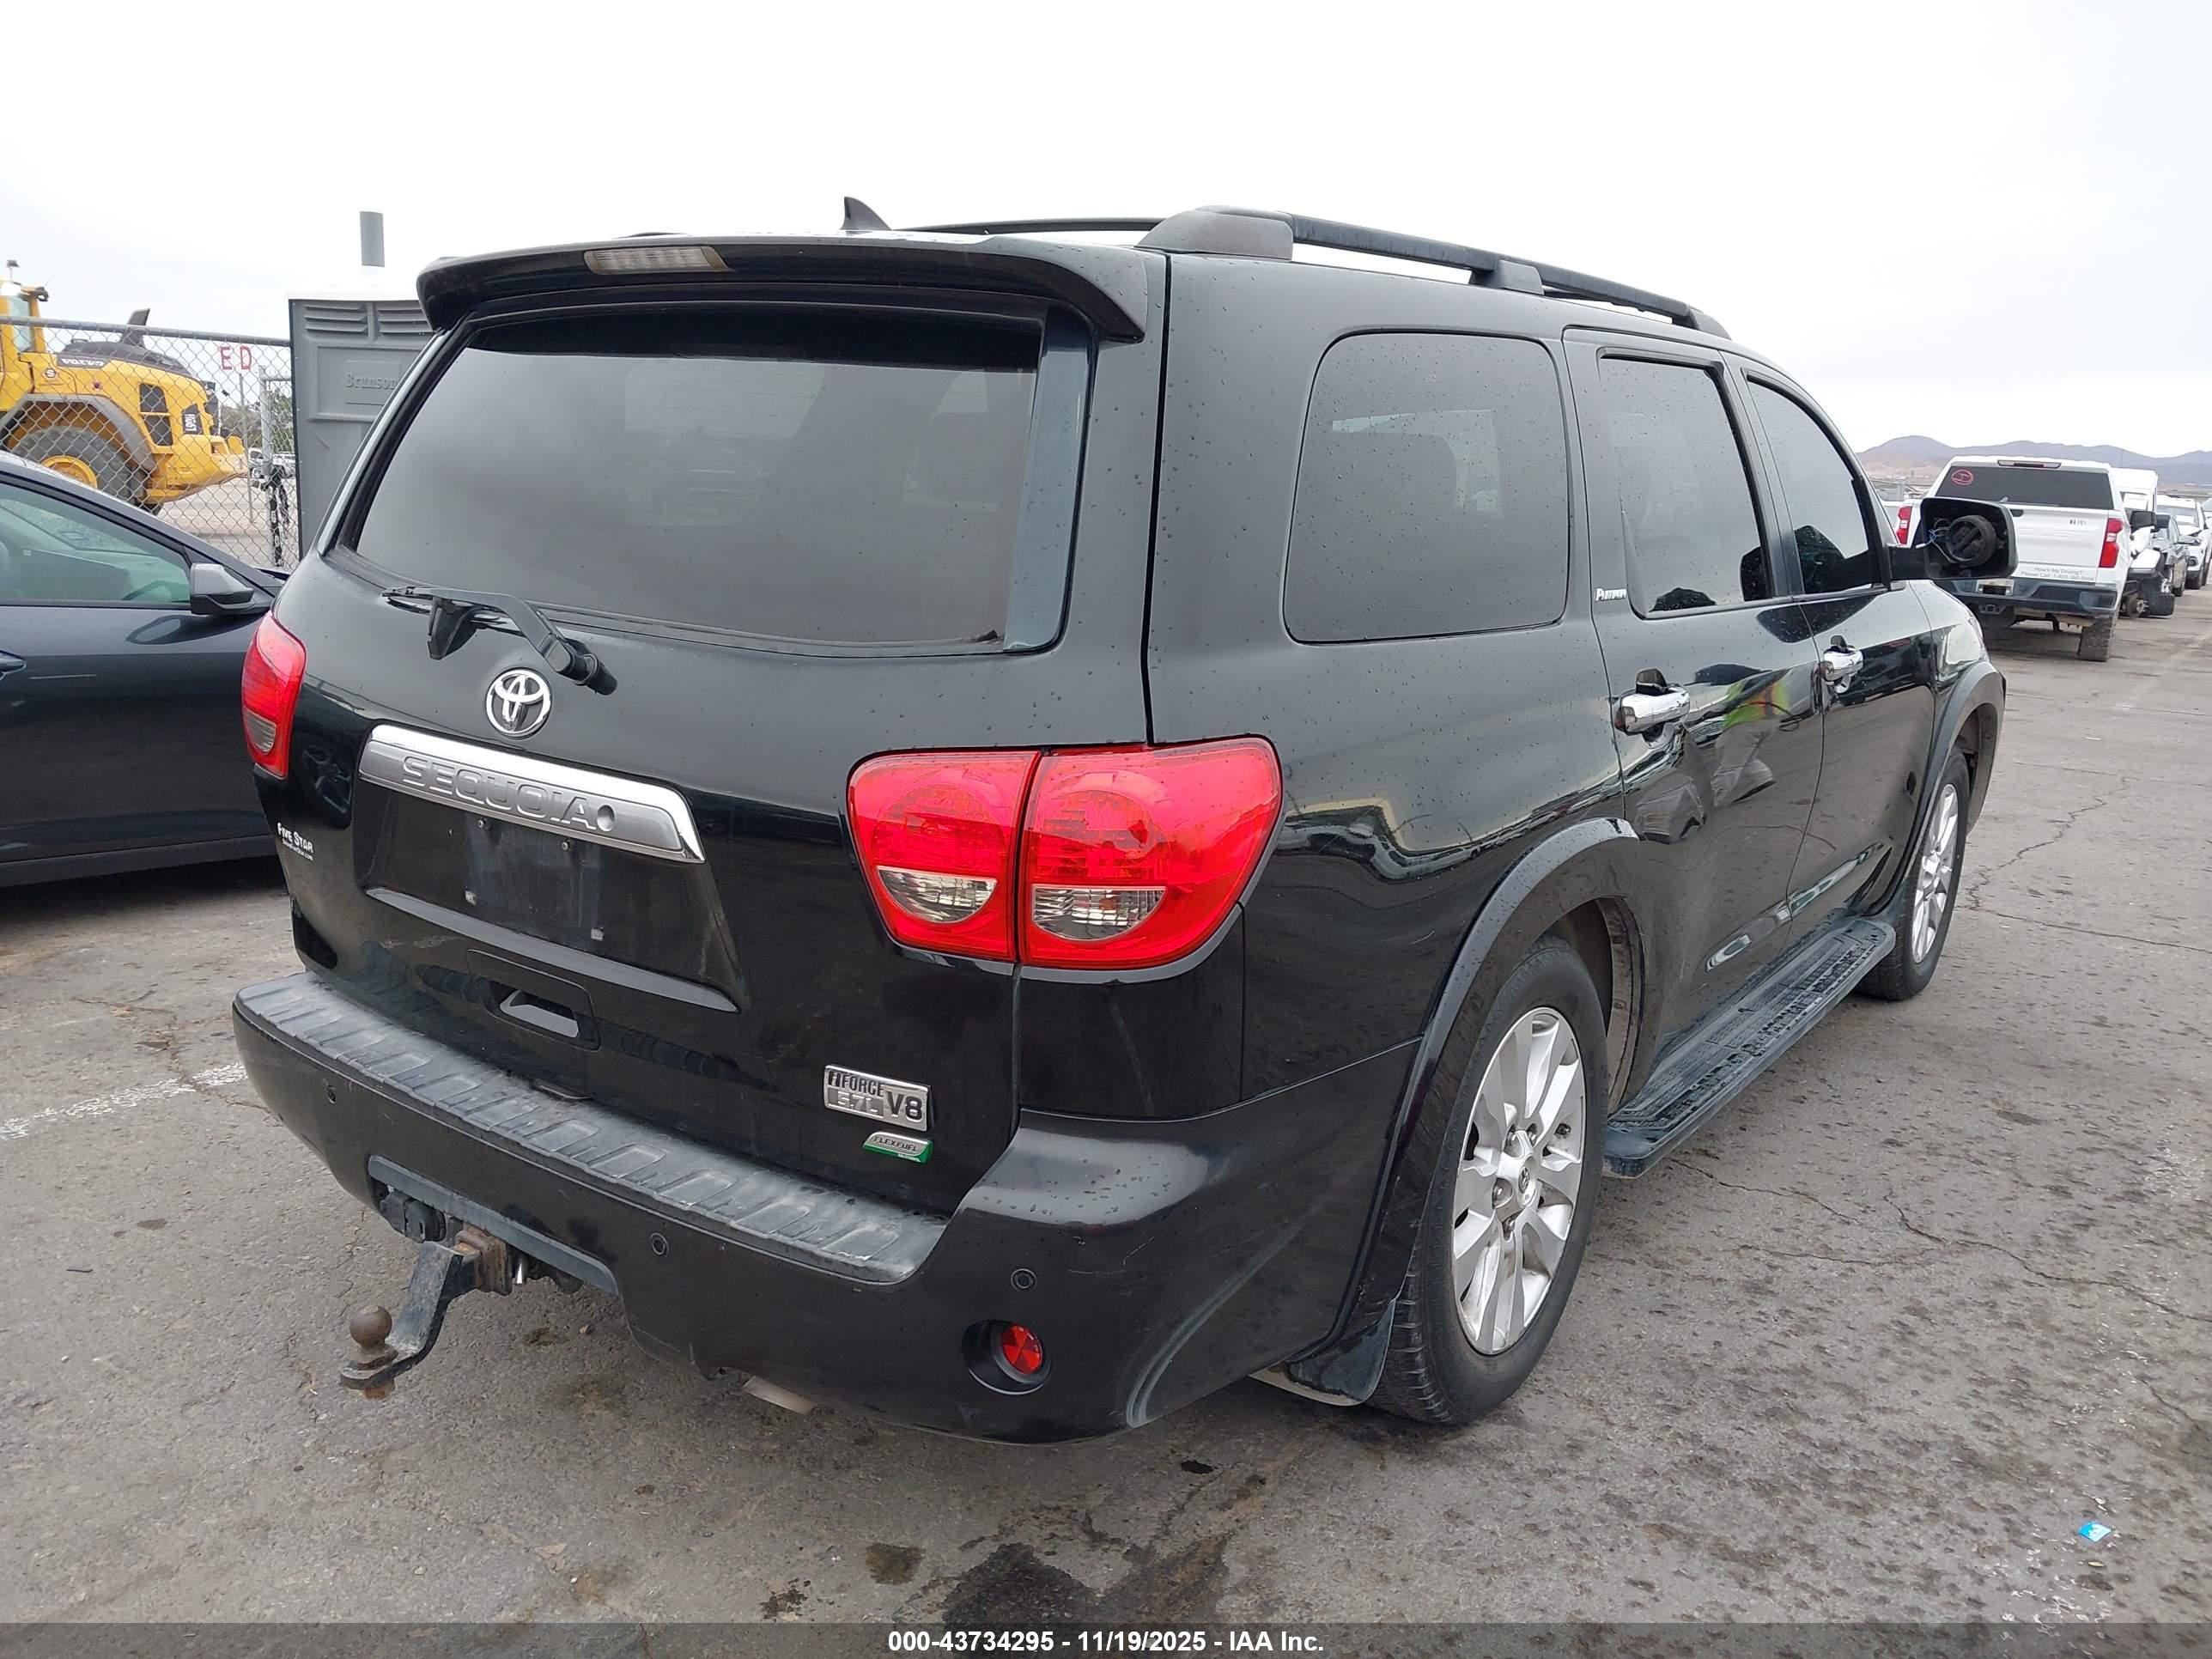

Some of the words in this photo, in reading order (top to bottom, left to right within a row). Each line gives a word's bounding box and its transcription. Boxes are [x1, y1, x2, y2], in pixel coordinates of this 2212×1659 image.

[60, 357, 104, 367] VOLVO
[403, 756, 597, 830] SEQUOIA
[276, 821, 294, 842] FIVE
[293, 830, 314, 854] STAR
[885, 1091, 923, 1121] V8
